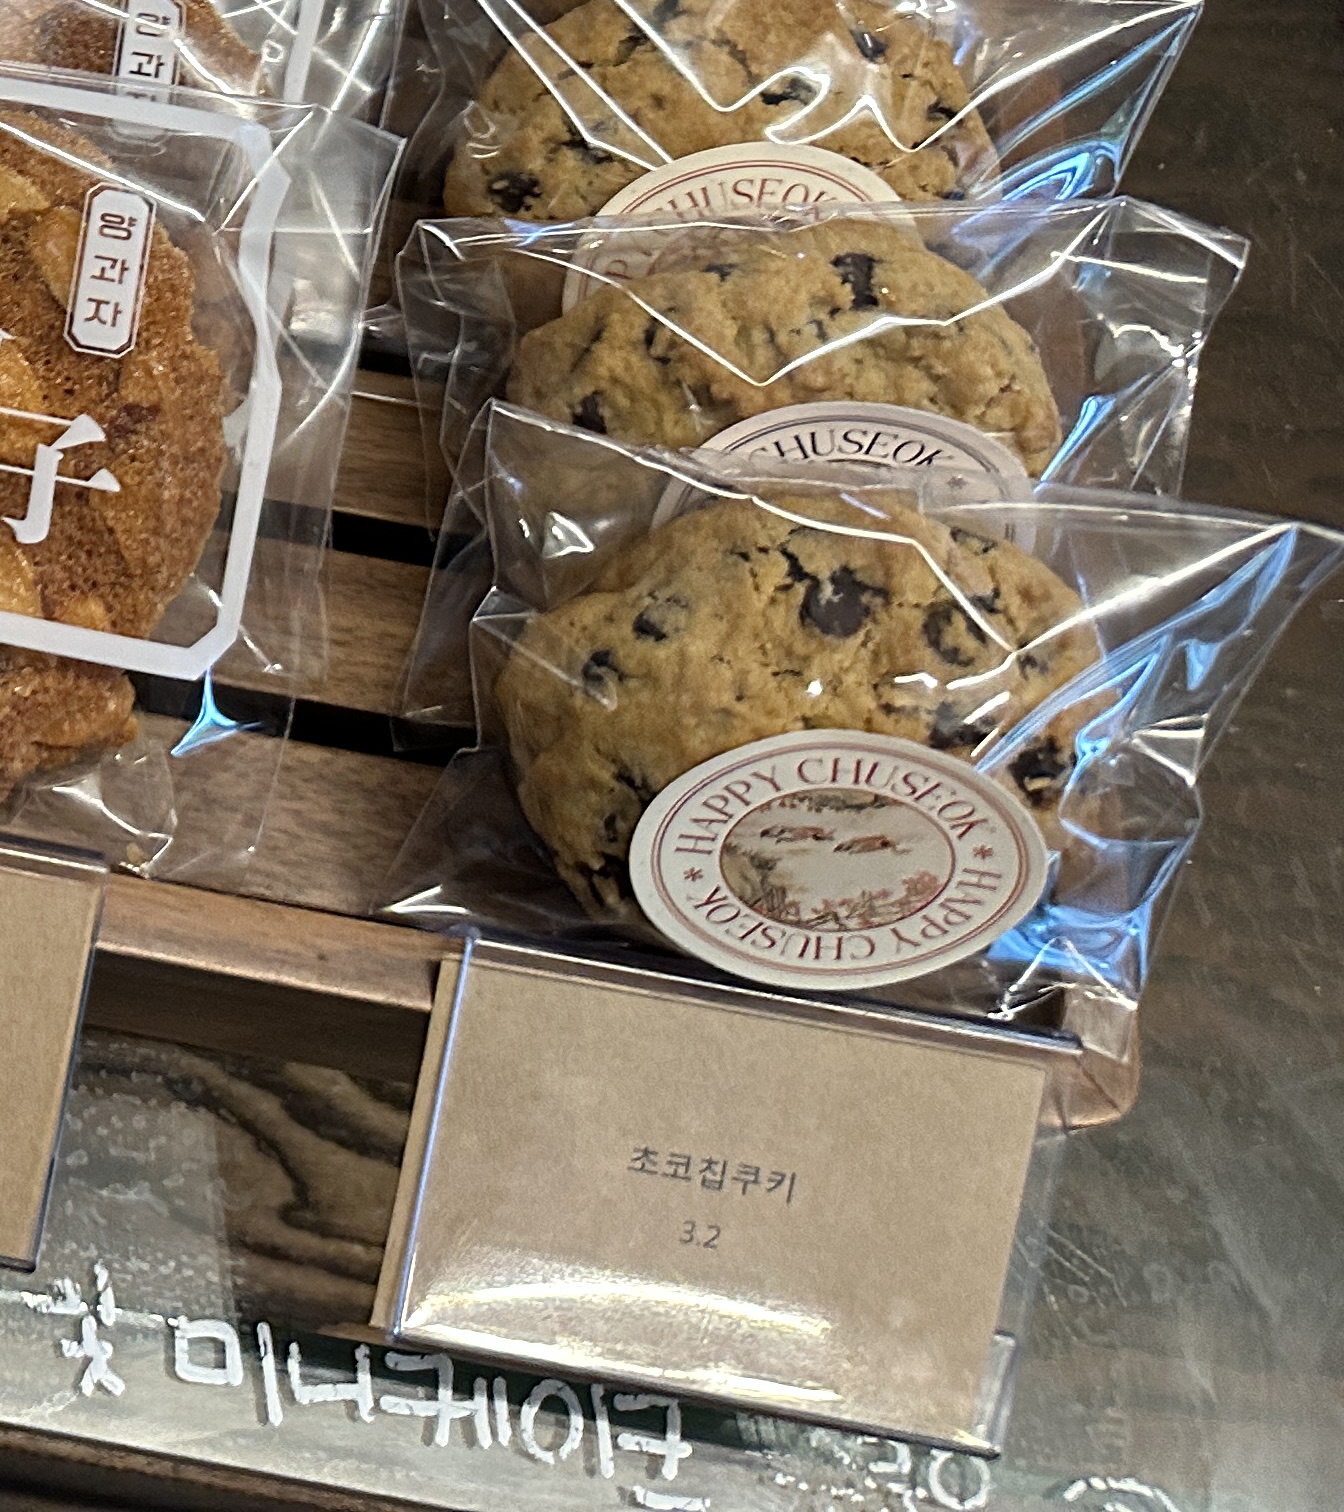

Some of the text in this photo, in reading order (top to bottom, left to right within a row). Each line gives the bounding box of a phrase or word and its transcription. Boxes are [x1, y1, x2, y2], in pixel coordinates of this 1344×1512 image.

[127, 11, 171, 102] 양과
[83, 212, 138, 328] 양과자
[675, 757, 990, 856] HAPPY CHUSEOK
[687, 867, 1002, 961] HAPPY CHUSEOK
[627, 1145, 798, 1205] 초코칩쿠키
[679, 1219, 722, 1250] 3.2
